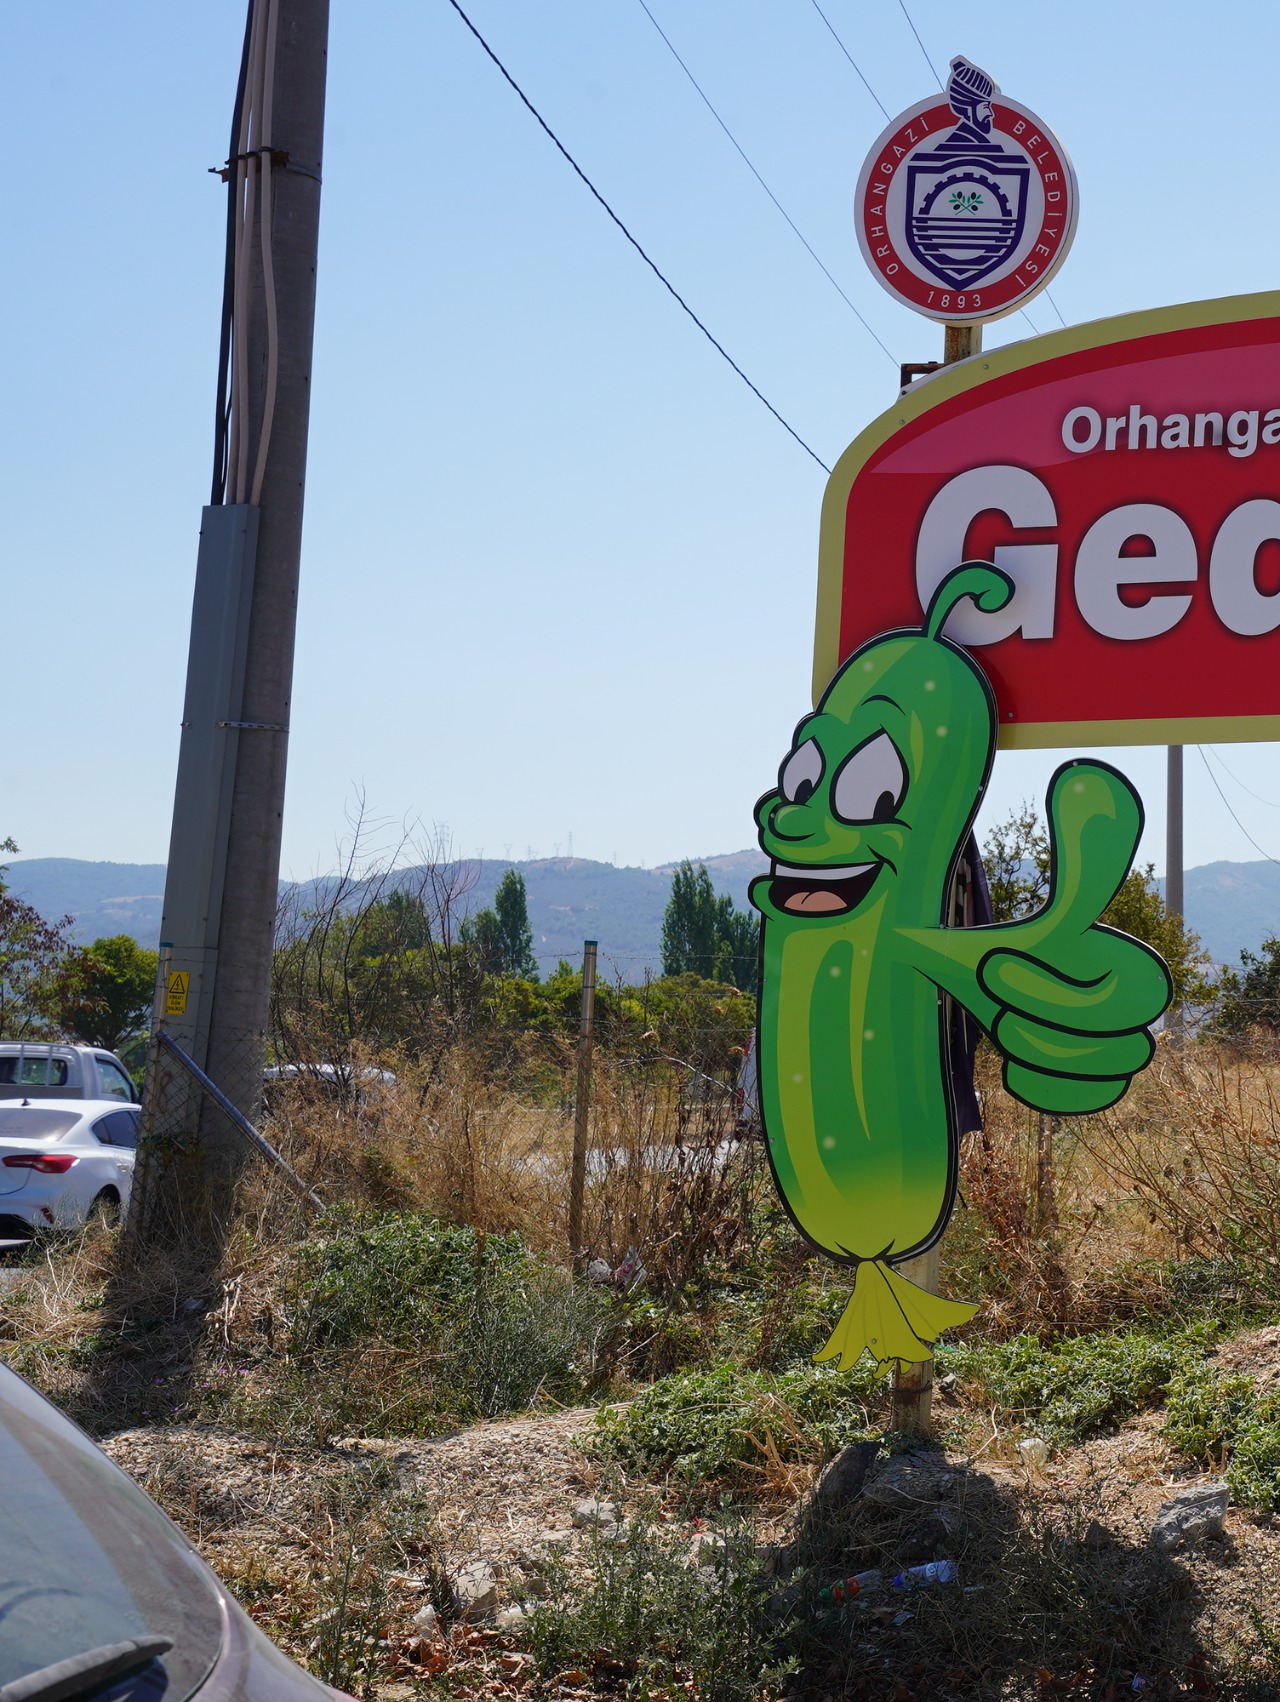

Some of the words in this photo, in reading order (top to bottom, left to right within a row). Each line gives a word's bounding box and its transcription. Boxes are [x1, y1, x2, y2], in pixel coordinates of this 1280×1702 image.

[870, 116, 930, 276] ORHANGAZİ
[1012, 120, 1063, 288] BELEDİYESİ
[926, 290, 982, 308] 1893
